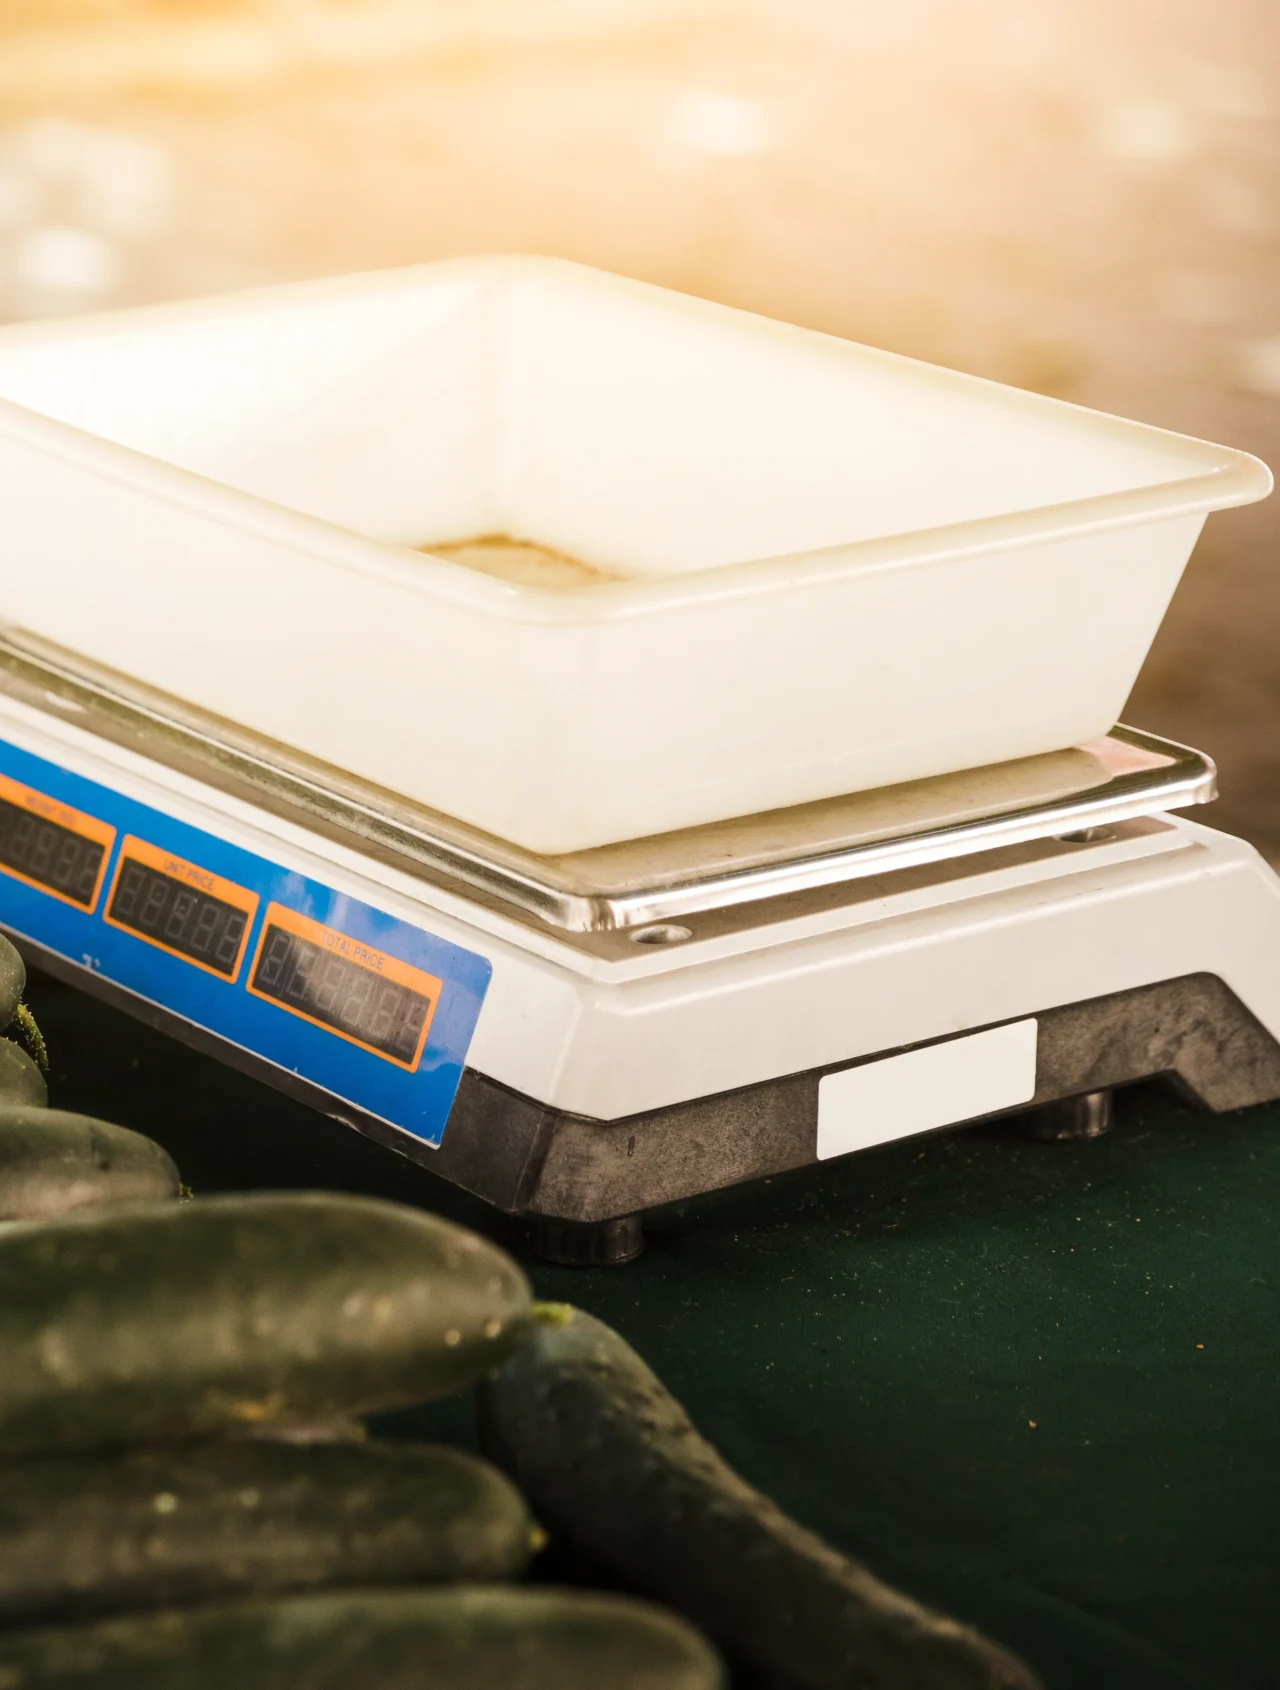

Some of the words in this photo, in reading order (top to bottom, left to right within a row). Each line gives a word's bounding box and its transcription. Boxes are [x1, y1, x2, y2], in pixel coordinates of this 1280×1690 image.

[186, 868, 215, 891] PRICE
[322, 931, 351, 955] TOTAL
[354, 946, 385, 971] PRICE
